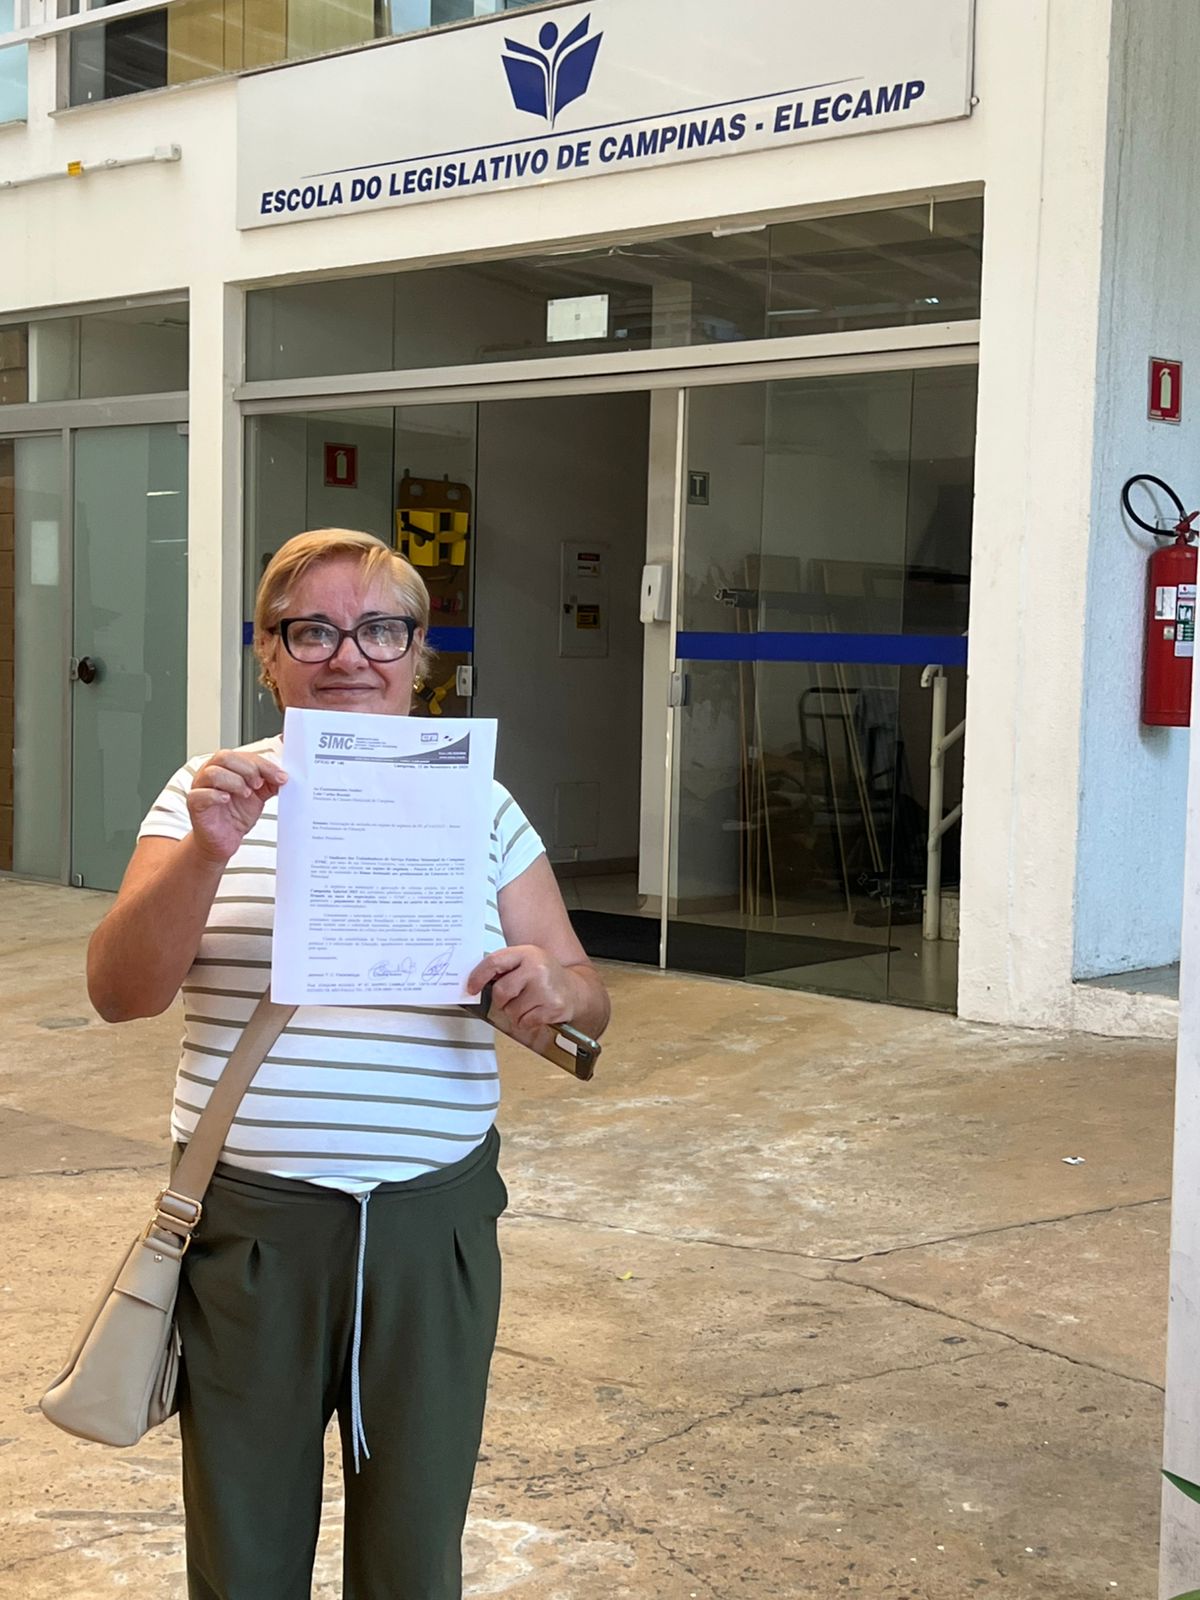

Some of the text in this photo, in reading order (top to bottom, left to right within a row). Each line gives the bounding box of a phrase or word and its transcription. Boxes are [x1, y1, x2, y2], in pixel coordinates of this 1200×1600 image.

[260, 80, 925, 215] ESCOLA DO LEGISLATIVO DE CAMPINAS - ELECAMP
